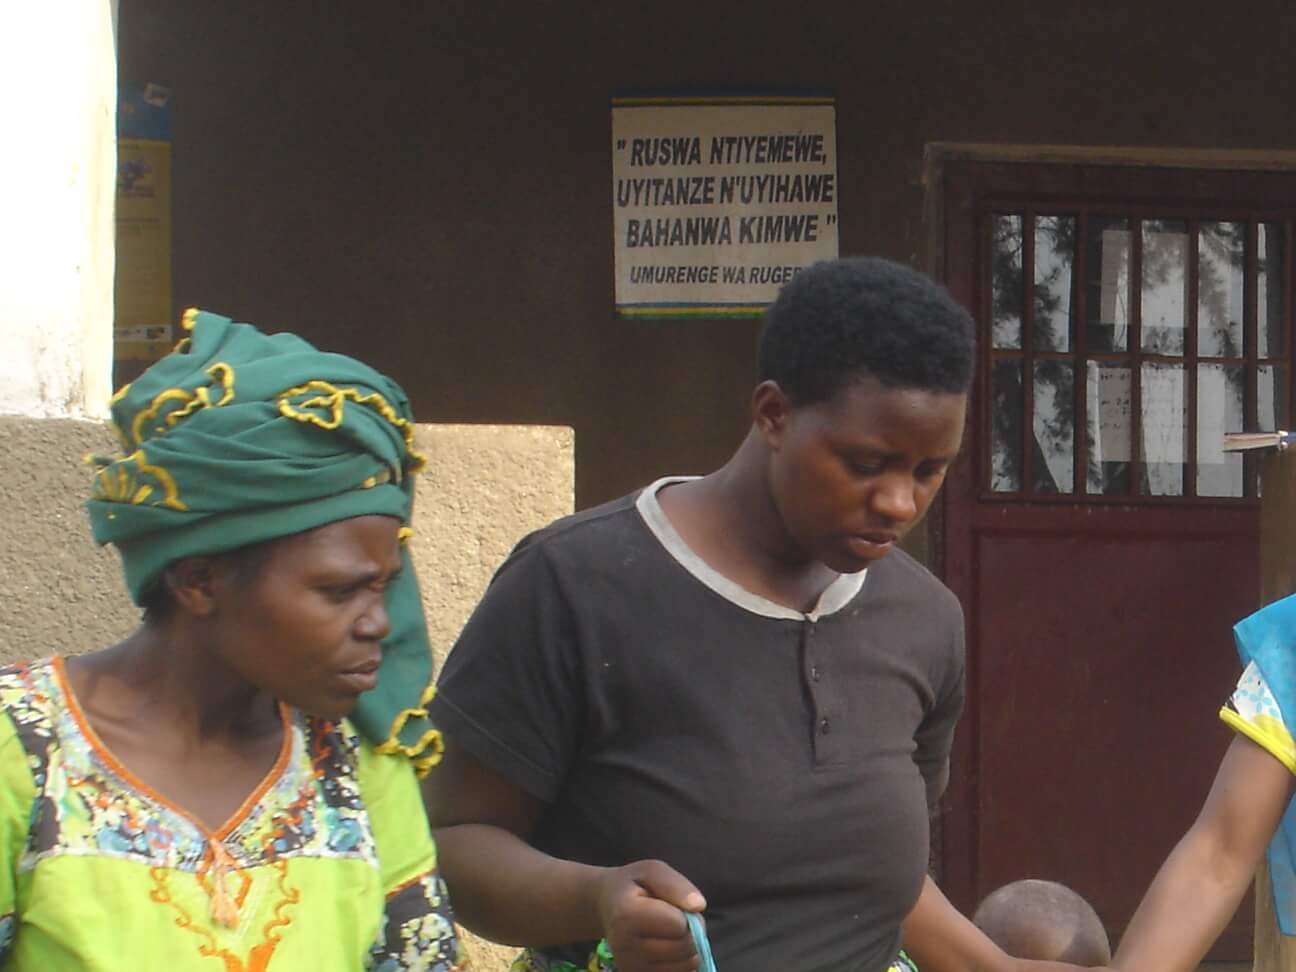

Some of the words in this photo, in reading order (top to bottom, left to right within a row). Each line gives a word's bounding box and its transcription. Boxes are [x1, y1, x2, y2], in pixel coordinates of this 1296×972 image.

[709, 134, 827, 166] NTIYEMEWE,
[617, 176, 714, 207] UYITANZE
[719, 174, 834, 204] N'UYIHAWE
[626, 216, 731, 248] BAHANWA
[630, 265, 718, 284] UMURENGE
[722, 266, 745, 284] WA
[749, 265, 803, 284] RUGE
